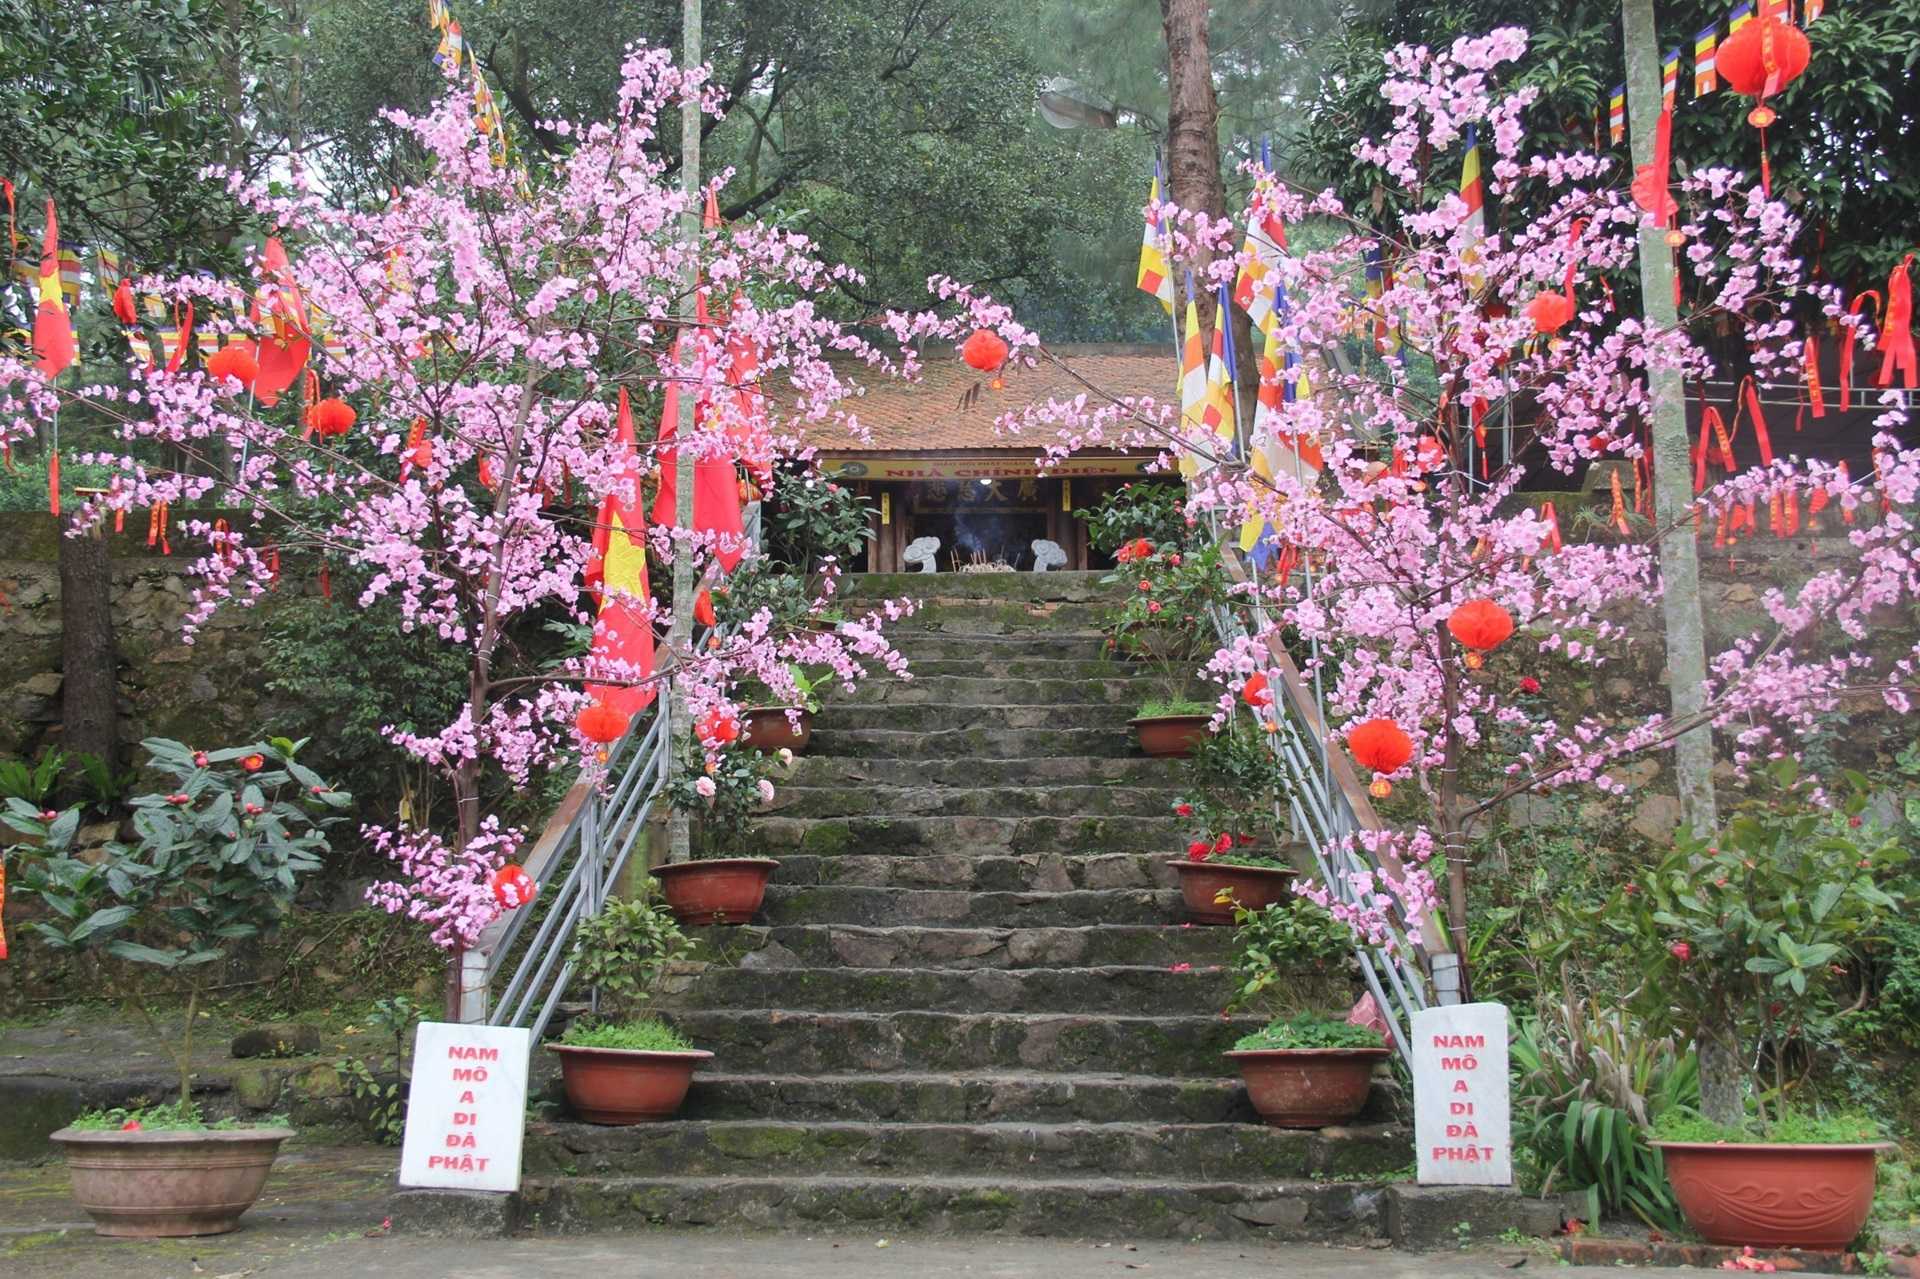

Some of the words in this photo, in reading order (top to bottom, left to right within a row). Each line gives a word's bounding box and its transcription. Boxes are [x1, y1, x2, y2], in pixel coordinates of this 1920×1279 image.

[954, 467, 1042, 476] CHÍNH
[1433, 1035, 1485, 1048] NAM
[448, 1046, 498, 1061] NAM
[1441, 1054, 1478, 1071] MÔ
[452, 1066, 488, 1082] MÔ
[1453, 1079, 1468, 1093] A
[459, 1090, 474, 1104] A
[1450, 1102, 1473, 1116] DI
[452, 1112, 477, 1126] DI
[1446, 1122, 1478, 1138] ĐÀ
[445, 1131, 476, 1149] ĐÀ
[1432, 1144, 1494, 1163] PHẬT
[427, 1153, 489, 1173] PHẬT
